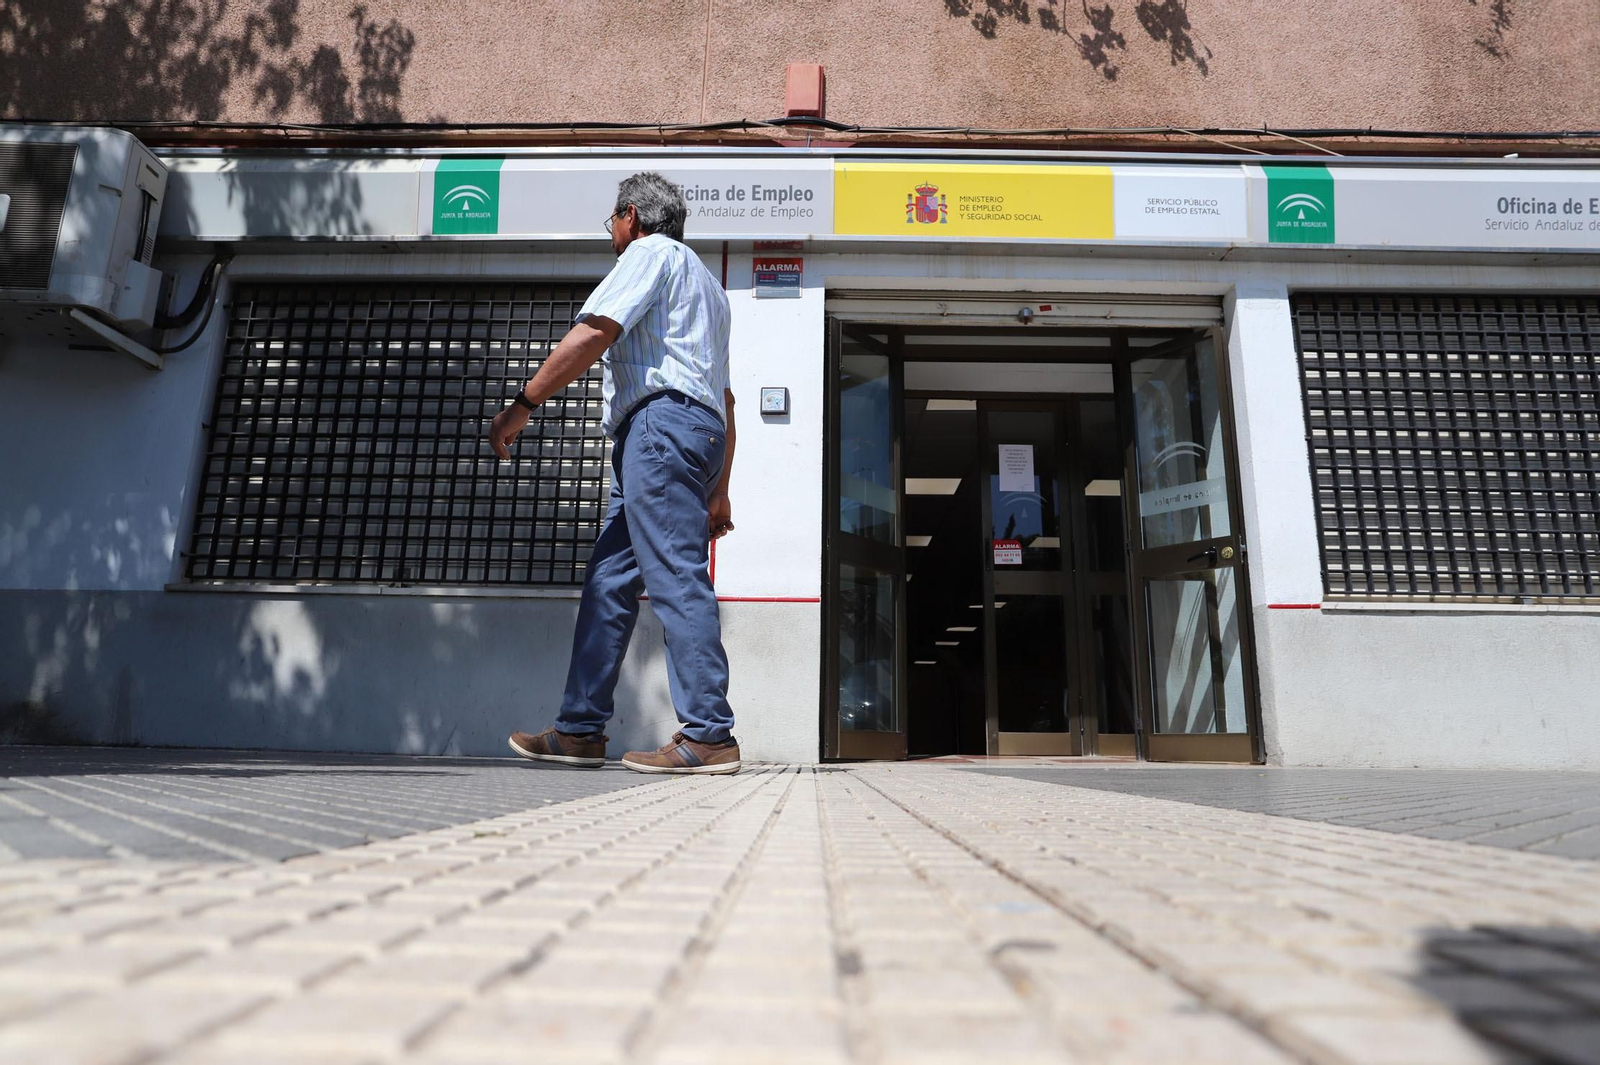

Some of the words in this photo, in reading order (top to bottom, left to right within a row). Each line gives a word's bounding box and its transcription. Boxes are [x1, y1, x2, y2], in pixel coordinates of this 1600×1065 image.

[679, 184, 720, 201] icina
[725, 184, 746, 201] de
[751, 184, 814, 206] Empleo
[959, 195, 1004, 204] MINISTERIO
[1147, 198, 1182, 206] SERVICIO
[1183, 198, 1218, 207] PÚBLICO
[1496, 196, 1557, 214] Oficina
[1562, 197, 1583, 215] de
[697, 206, 746, 218] Andaluz
[750, 206, 765, 218] de
[770, 206, 814, 220] Empleo
[959, 204, 971, 212] DE
[972, 204, 1003, 212] EMPLEO
[1145, 206, 1156, 214] DE
[1157, 207, 1188, 215] EMPLEO
[1189, 207, 1221, 216] ESTATAL
[966, 213, 1012, 221] SEGURIDAD
[1013, 213, 1043, 221] SOCIAL
[1484, 218, 1530, 231] Servicio
[1534, 219, 1584, 231] Andaluz
